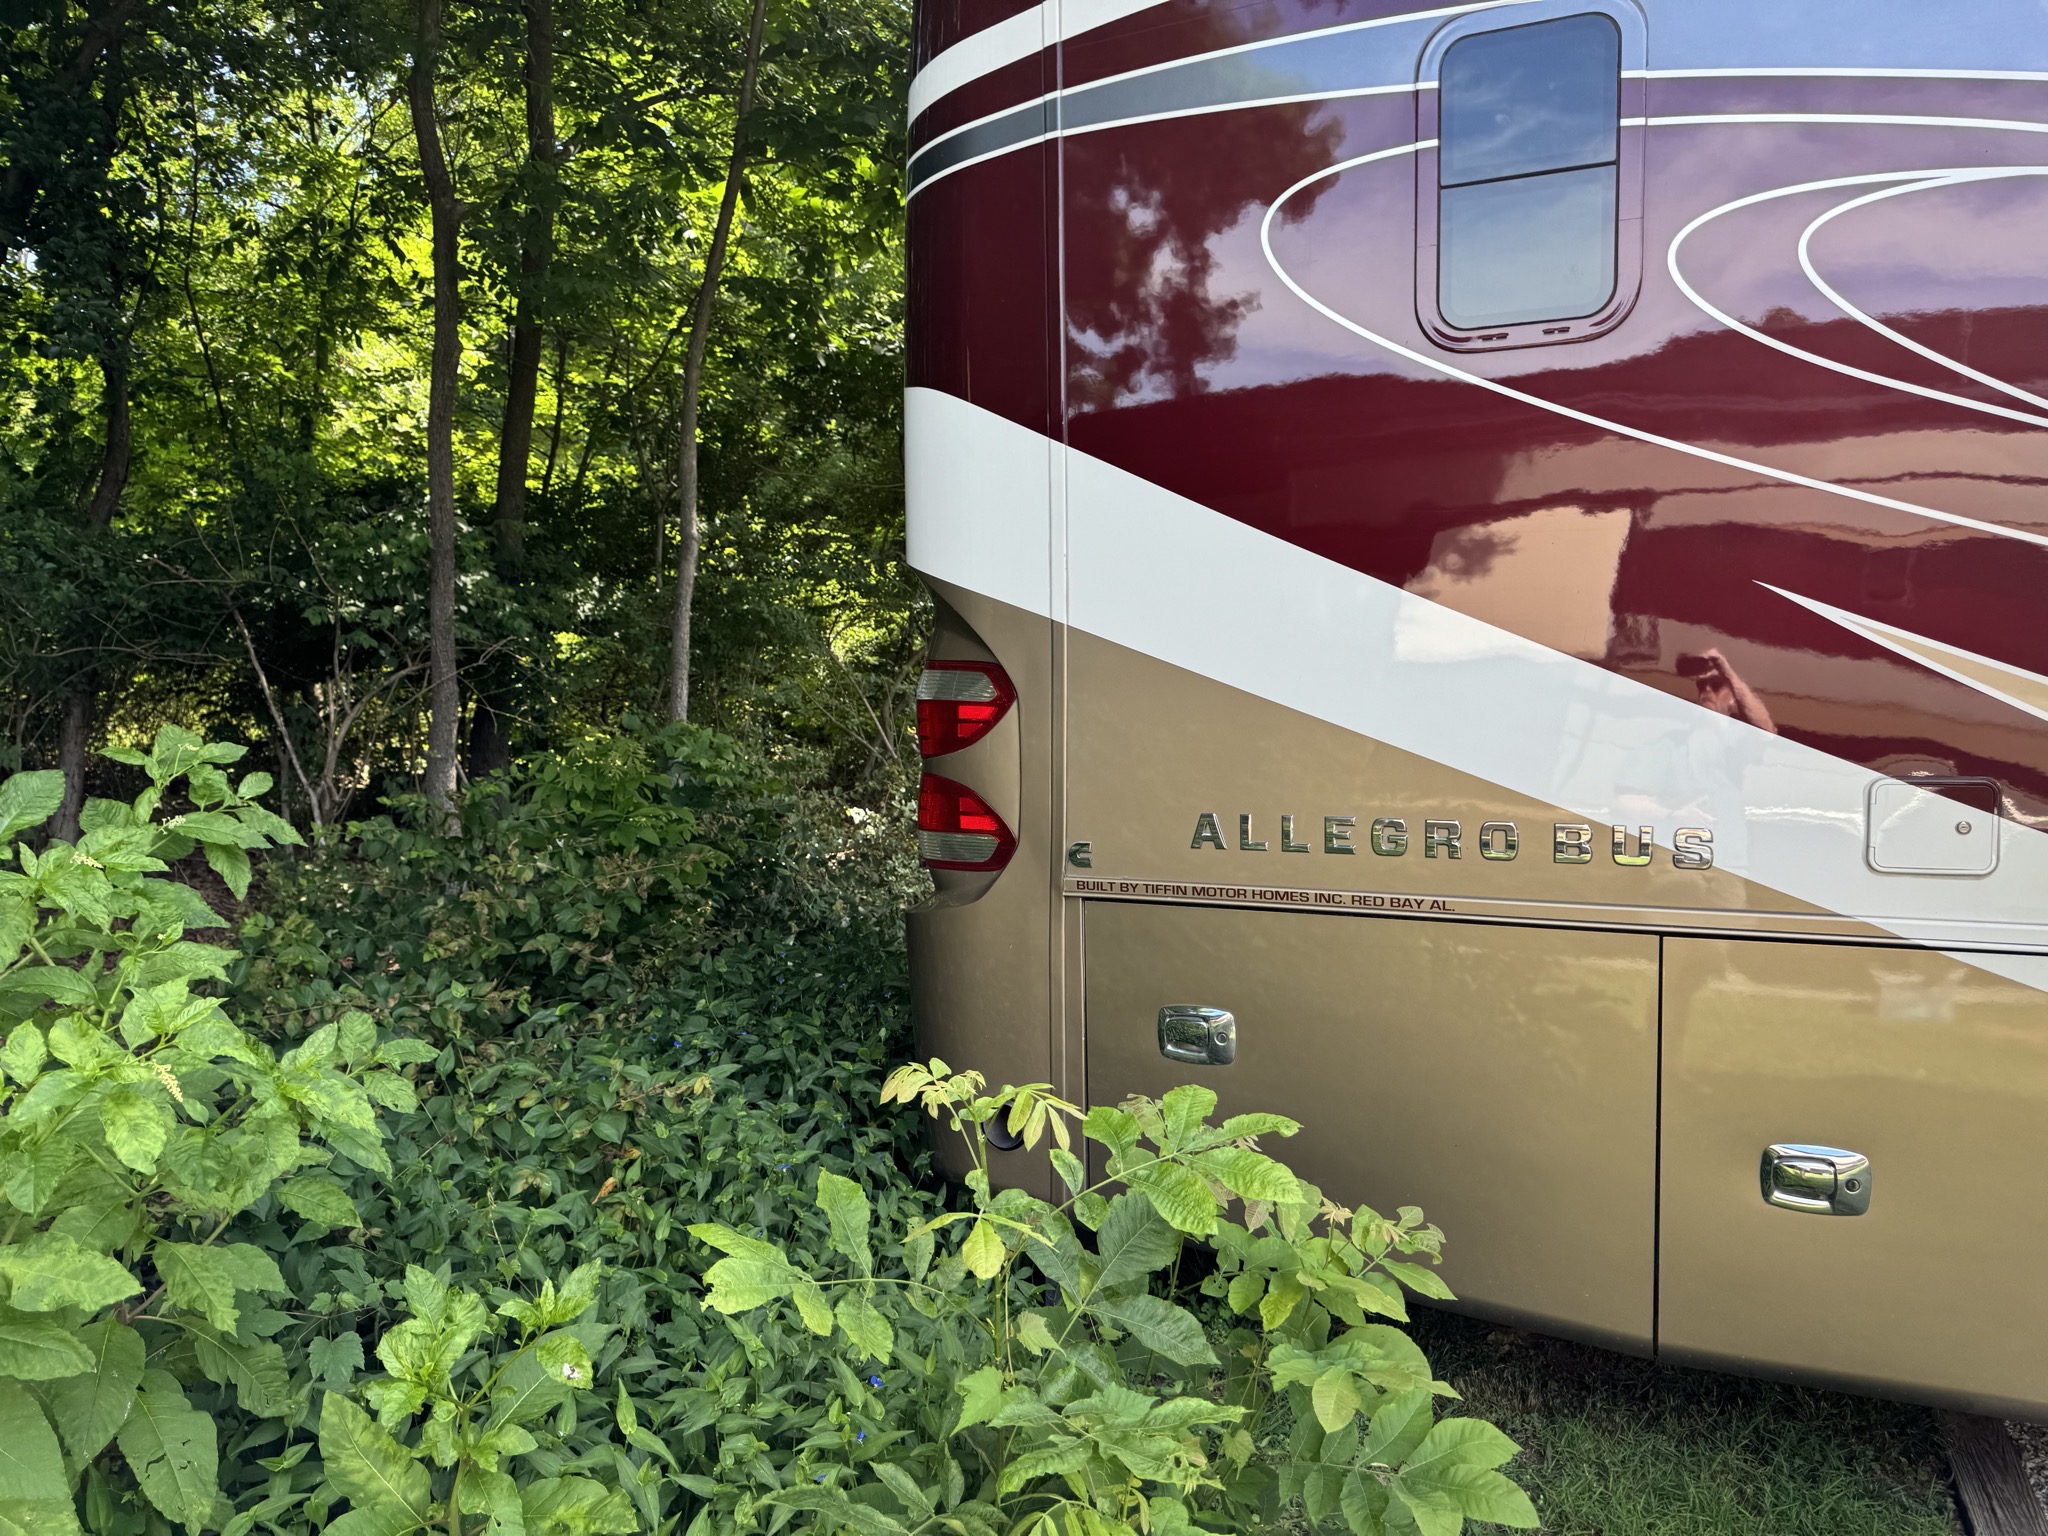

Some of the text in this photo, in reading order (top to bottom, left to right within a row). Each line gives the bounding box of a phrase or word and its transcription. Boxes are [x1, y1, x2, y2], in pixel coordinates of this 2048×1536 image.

[1190, 812, 1714, 870] ALLEGRO BUS
[1076, 880, 1456, 912] BUILT BY TIFFIN MOTOR HOMES INC. RED BAY AL.
